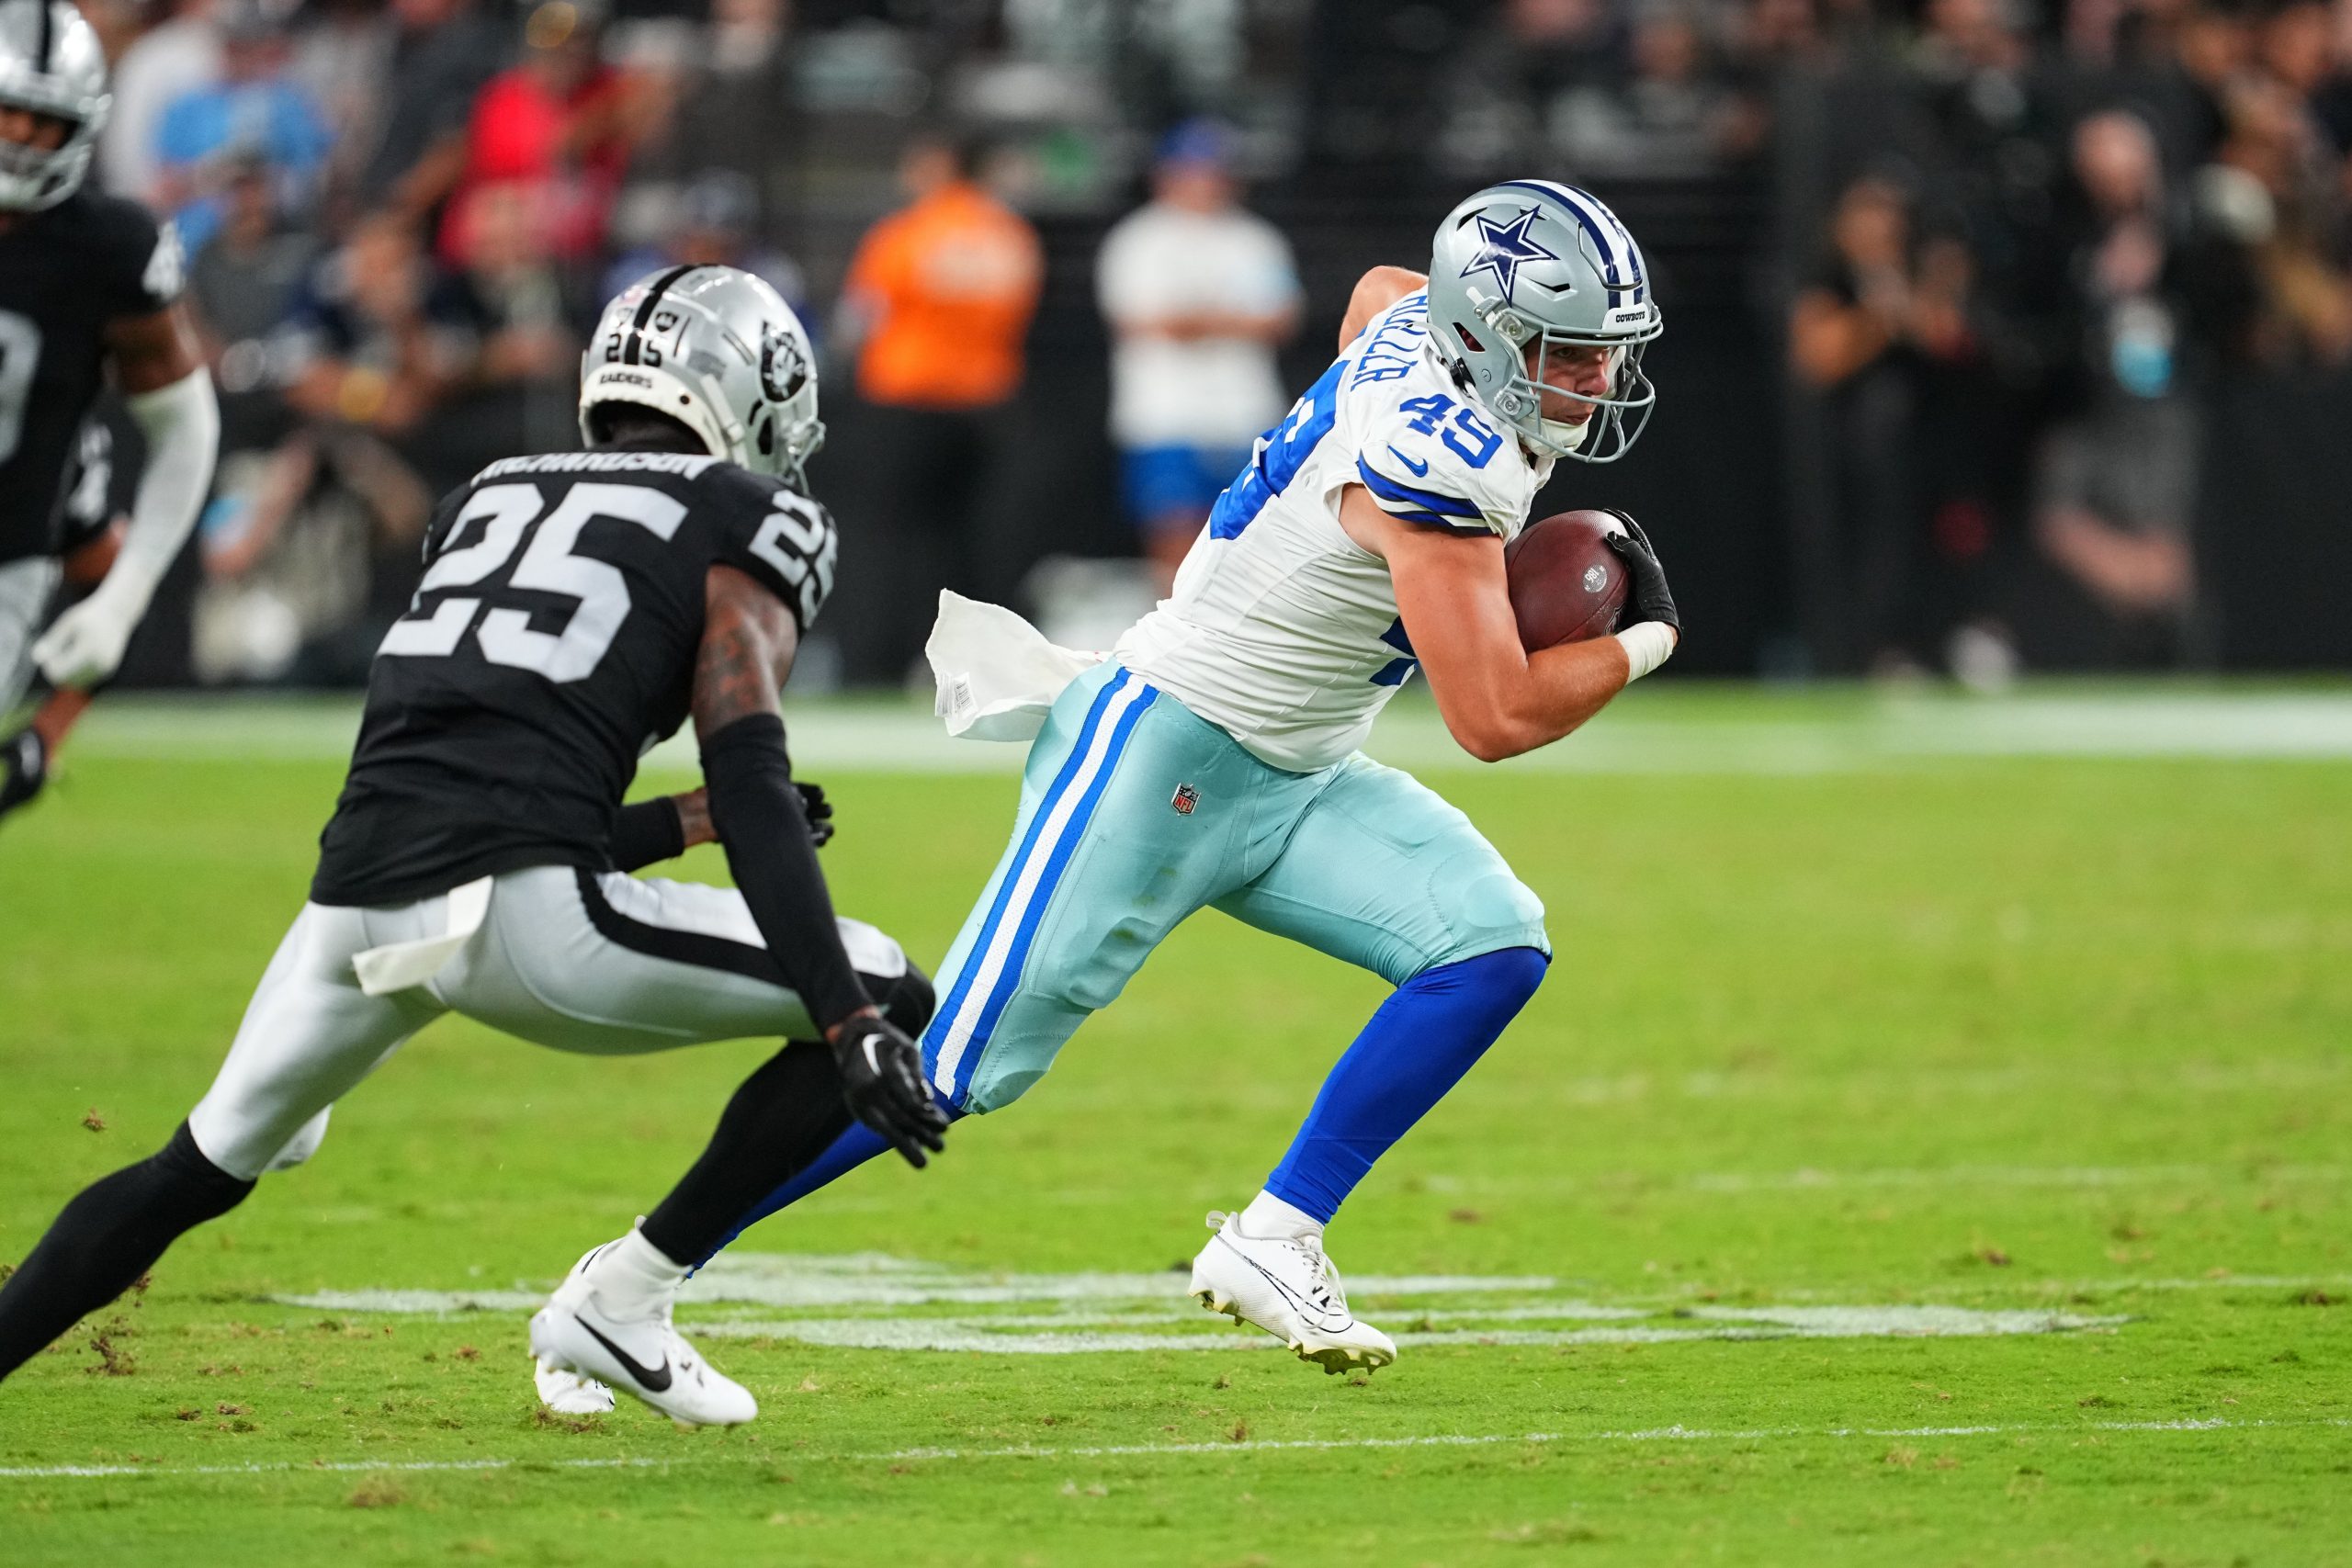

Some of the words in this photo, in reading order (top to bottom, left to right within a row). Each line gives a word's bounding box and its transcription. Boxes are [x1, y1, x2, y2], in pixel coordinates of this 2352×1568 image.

[1615, 310, 1645, 323] COWBOYS
[1399, 393, 1503, 469] 49
[375, 481, 689, 683] 25
